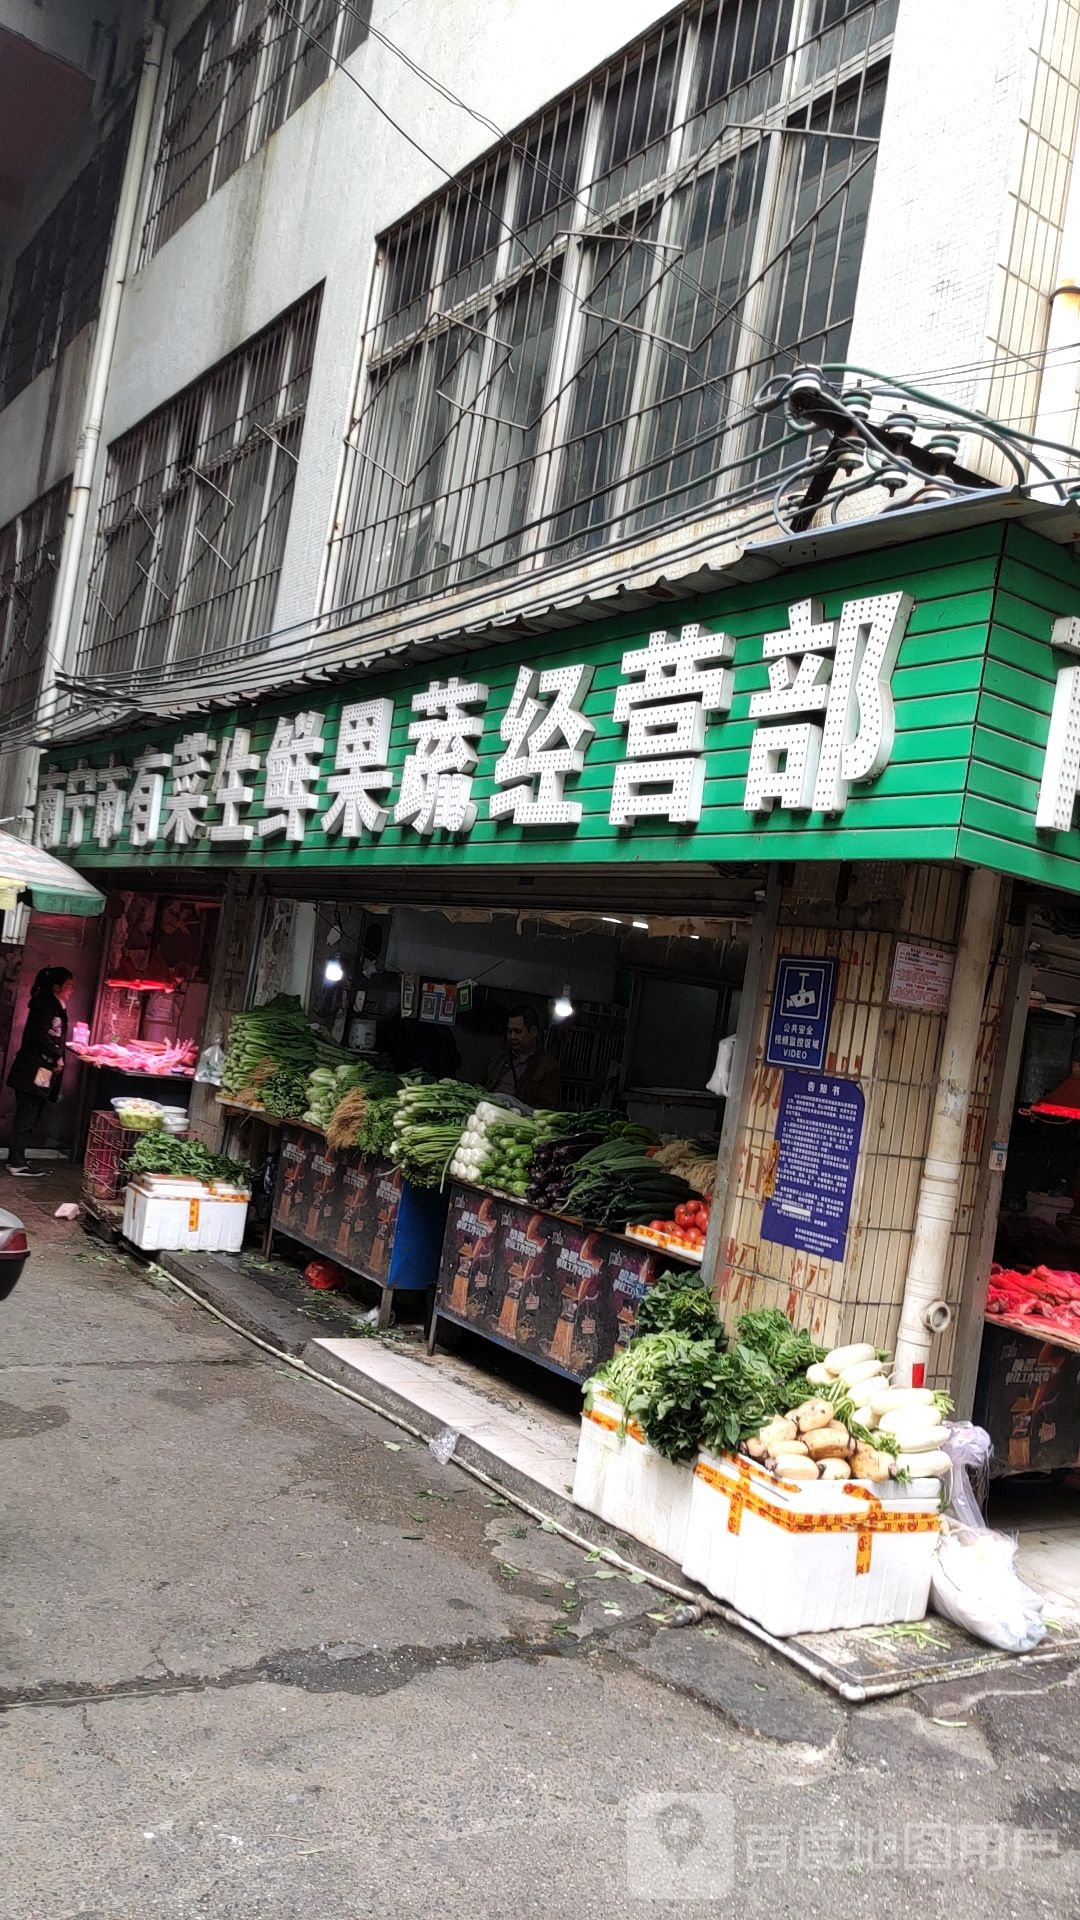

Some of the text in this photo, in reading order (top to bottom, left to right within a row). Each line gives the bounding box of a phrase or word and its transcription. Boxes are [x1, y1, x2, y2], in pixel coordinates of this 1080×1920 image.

[34, 591, 914, 849] 南宁市有菜生鲜果蔬经营部
[783, 1023, 814, 1035] 公共安全
[774, 1034, 820, 1050] 视频监控区域
[782, 1048, 808, 1060] VIDEO
[807, 1082, 841, 1097] 告知书
